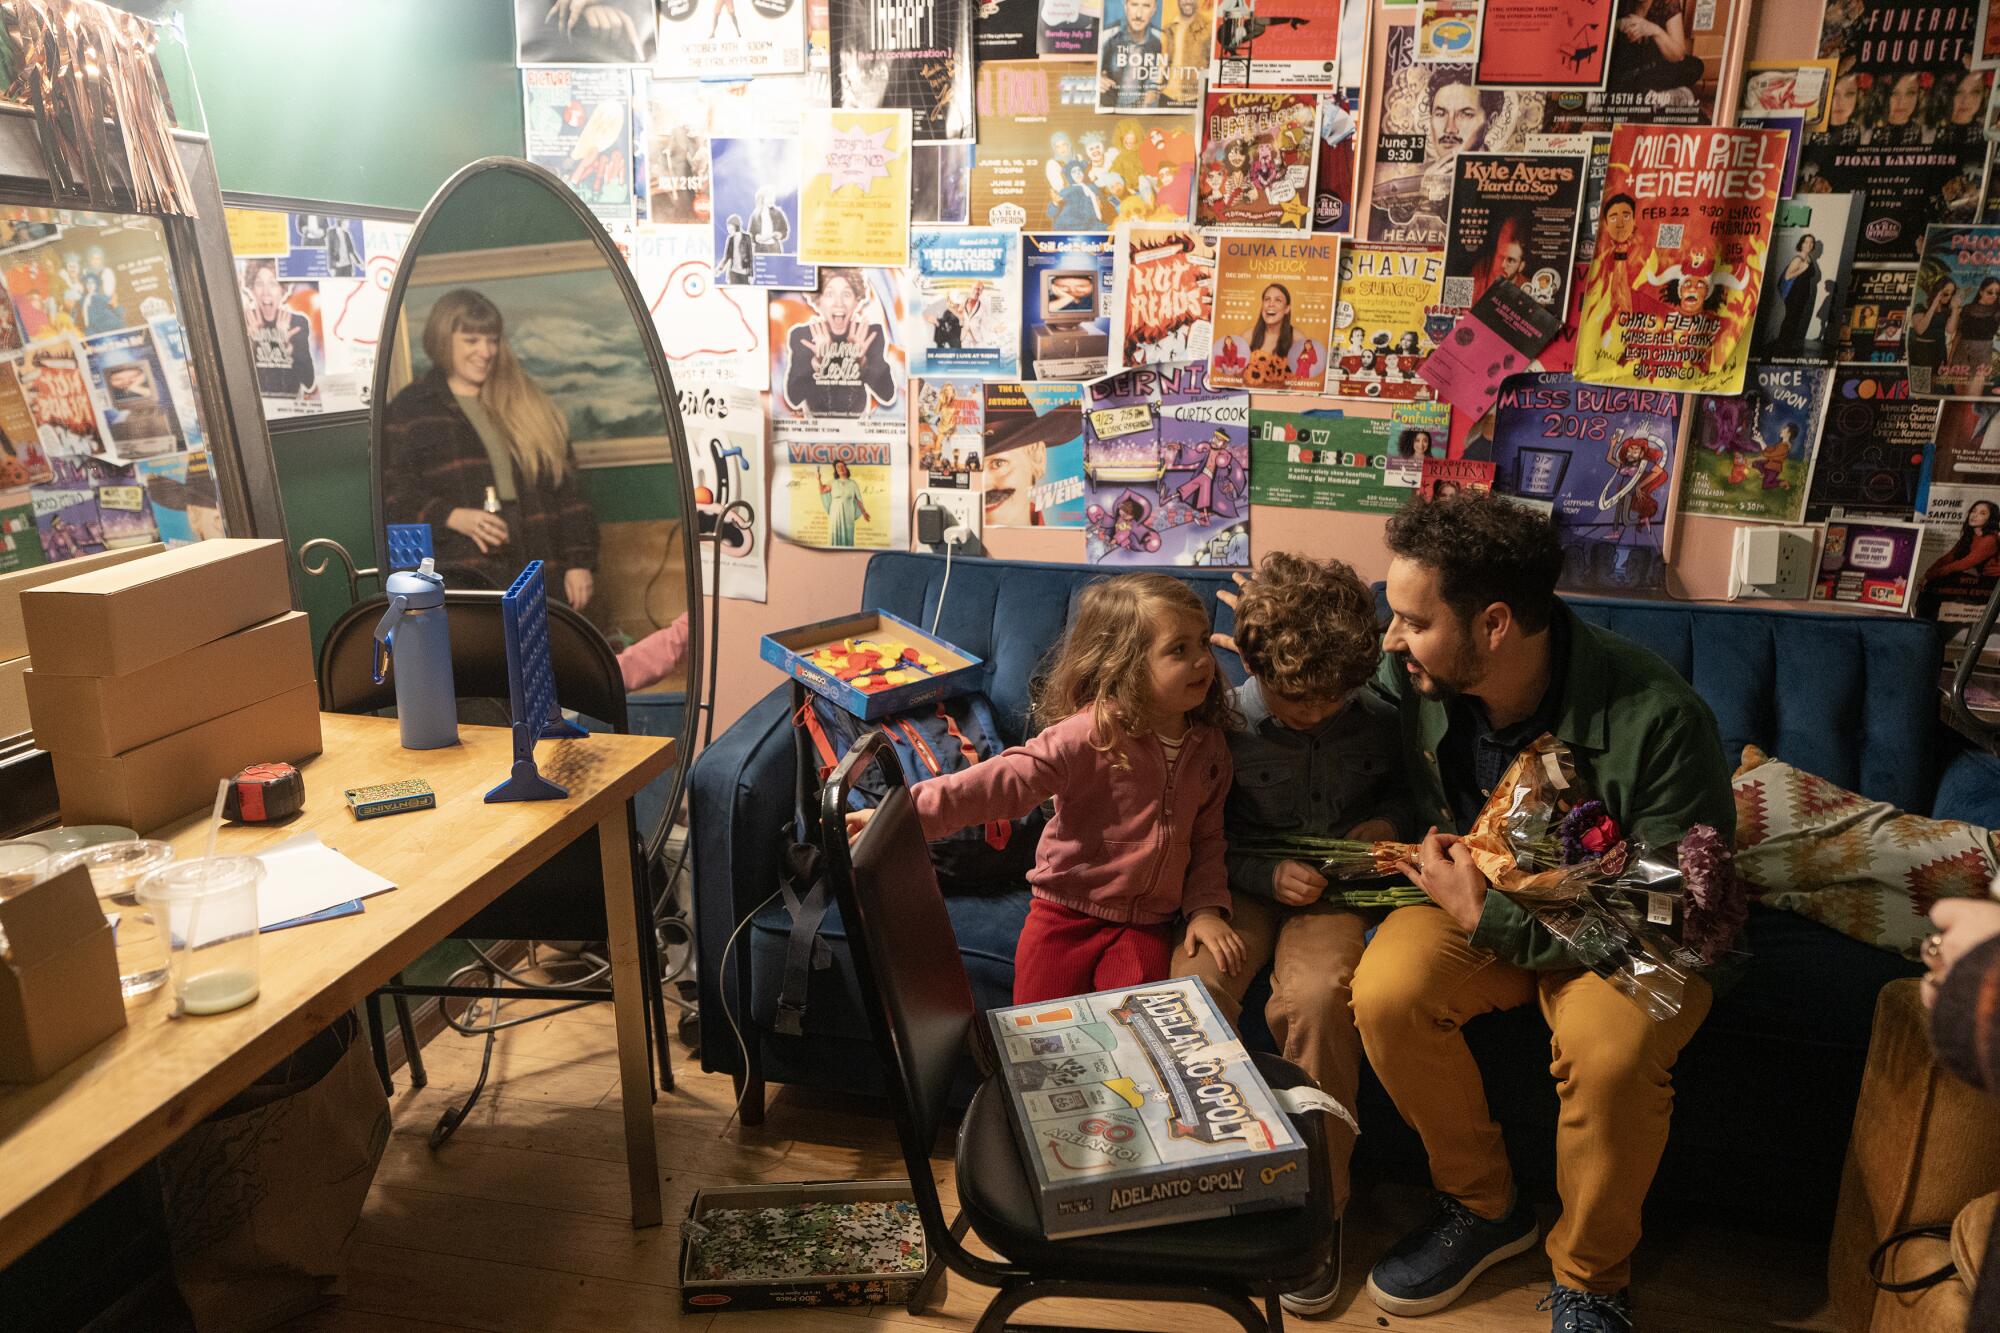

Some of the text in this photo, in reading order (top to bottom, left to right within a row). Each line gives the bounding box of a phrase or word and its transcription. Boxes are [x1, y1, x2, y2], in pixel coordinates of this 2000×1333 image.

[1869, 8, 1969, 33] FUNERAL
[1117, 52, 1168, 67] BORN
[1861, 39, 1963, 63] BOUQUET
[1132, 66, 1200, 80] IDENTITY
[1611, 93, 1633, 104] 15TH
[1379, 136, 1424, 147] June 13
[1388, 149, 1413, 160] 9:30
[1630, 134, 1700, 169] MILAN
[1706, 133, 1776, 169] PATEL
[1835, 154, 1957, 166] FIONA LANDERS
[1464, 161, 1575, 182] Kyle Ayers
[1476, 180, 1558, 194] Hard to Say
[1642, 205, 1667, 220] FEB
[1670, 206, 1690, 217] 22
[1384, 229, 1447, 242] HEAVEN
[945, 248, 1003, 260] FREQUENT
[1228, 243, 1330, 259] OLIVIA LEVINE
[931, 260, 995, 272] FLOATERS
[1249, 259, 1307, 273] UNSTUCK
[1338, 255, 1442, 283] SHAME
[1131, 263, 1191, 294] HOT
[1130, 289, 1202, 330] READS
[1619, 311, 1721, 333] CHRIS FLEMING
[1758, 371, 1802, 386] ONCE
[988, 398, 1028, 406] SATURDAY
[1499, 388, 1678, 417] MISS BULGARIA
[1773, 389, 1808, 411] UPON
[1174, 405, 1248, 423] CURTIS COOK
[1393, 411, 1450, 425] Confused
[1543, 413, 1608, 441] 2018
[789, 443, 890, 465] VICTORY!
[1932, 499, 1963, 508] SOPHIE
[1927, 511, 1964, 521] SANTOS
[362, 797, 429, 815] FONTAINE
[1135, 992, 1227, 1079] ADELANO
[1079, 1118, 1136, 1145] GO
[1042, 1127, 1142, 1163] ADELANTO!
[1109, 1179, 1193, 1211] ADELANTO
[1198, 1168, 1247, 1193] OPOLY
